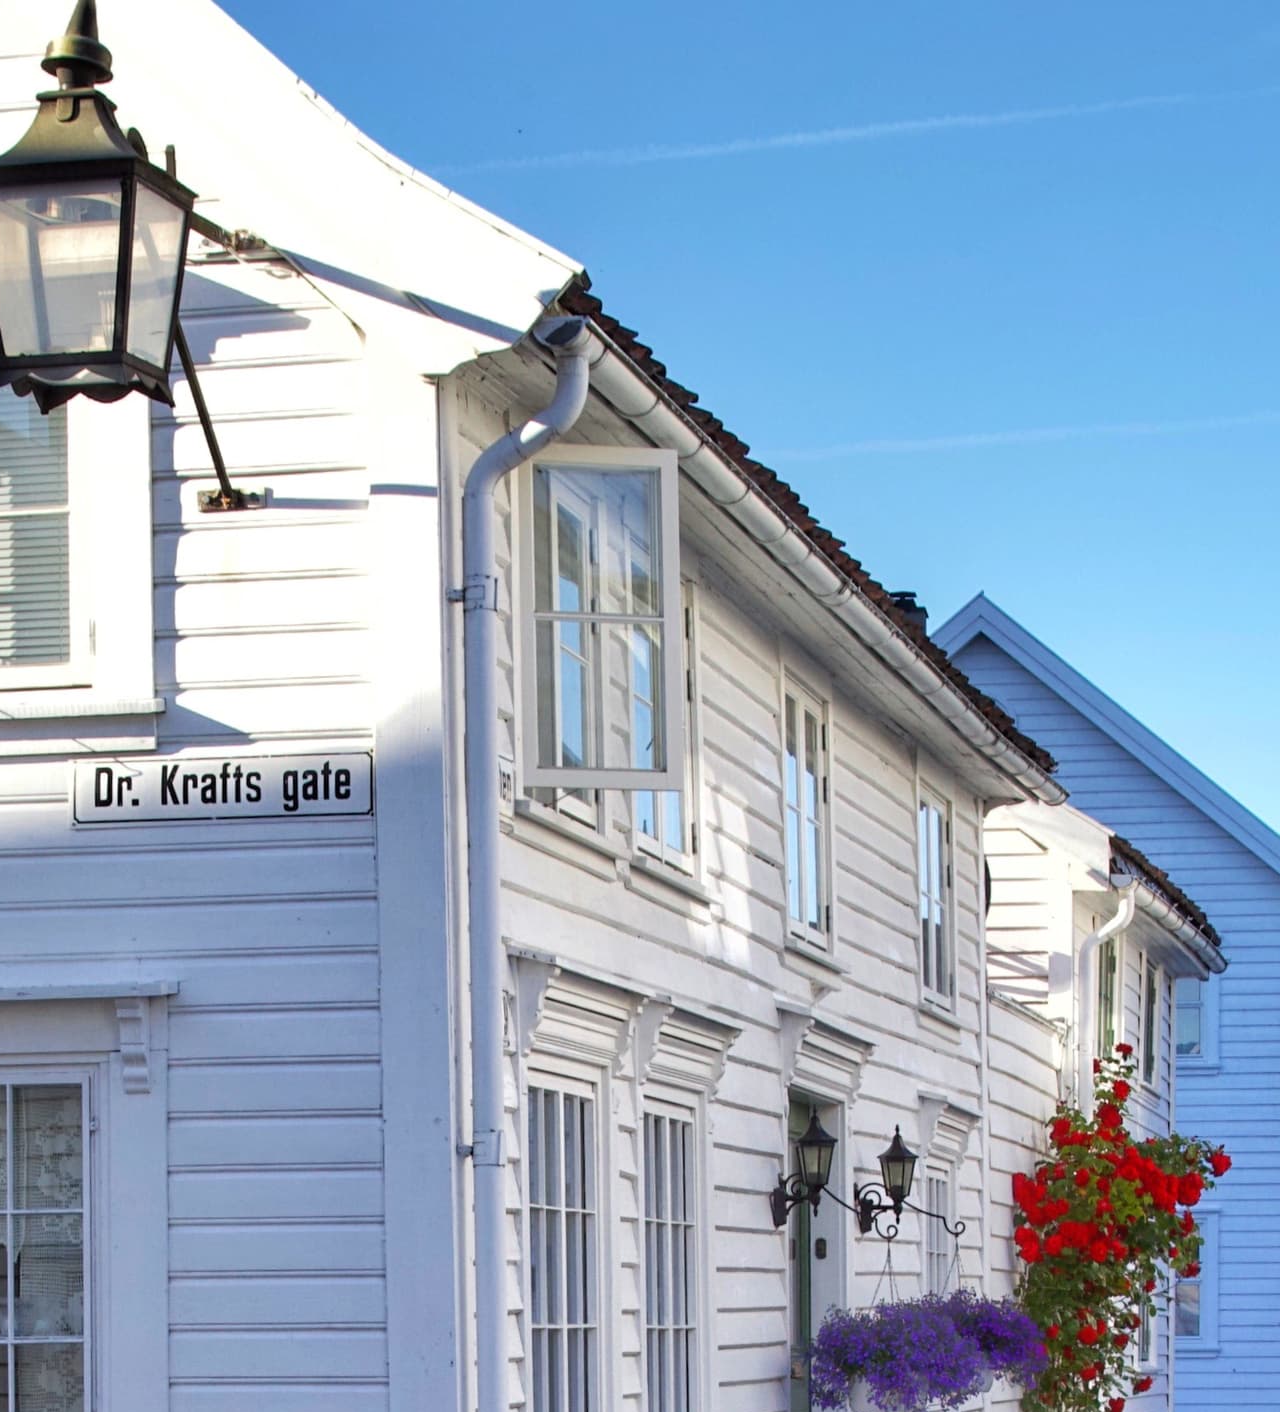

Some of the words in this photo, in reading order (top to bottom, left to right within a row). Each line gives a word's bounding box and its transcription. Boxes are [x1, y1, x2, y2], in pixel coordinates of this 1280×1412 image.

[94, 767, 140, 807] Dr.
[160, 762, 262, 806] Krafts
[282, 759, 351, 812] gate
